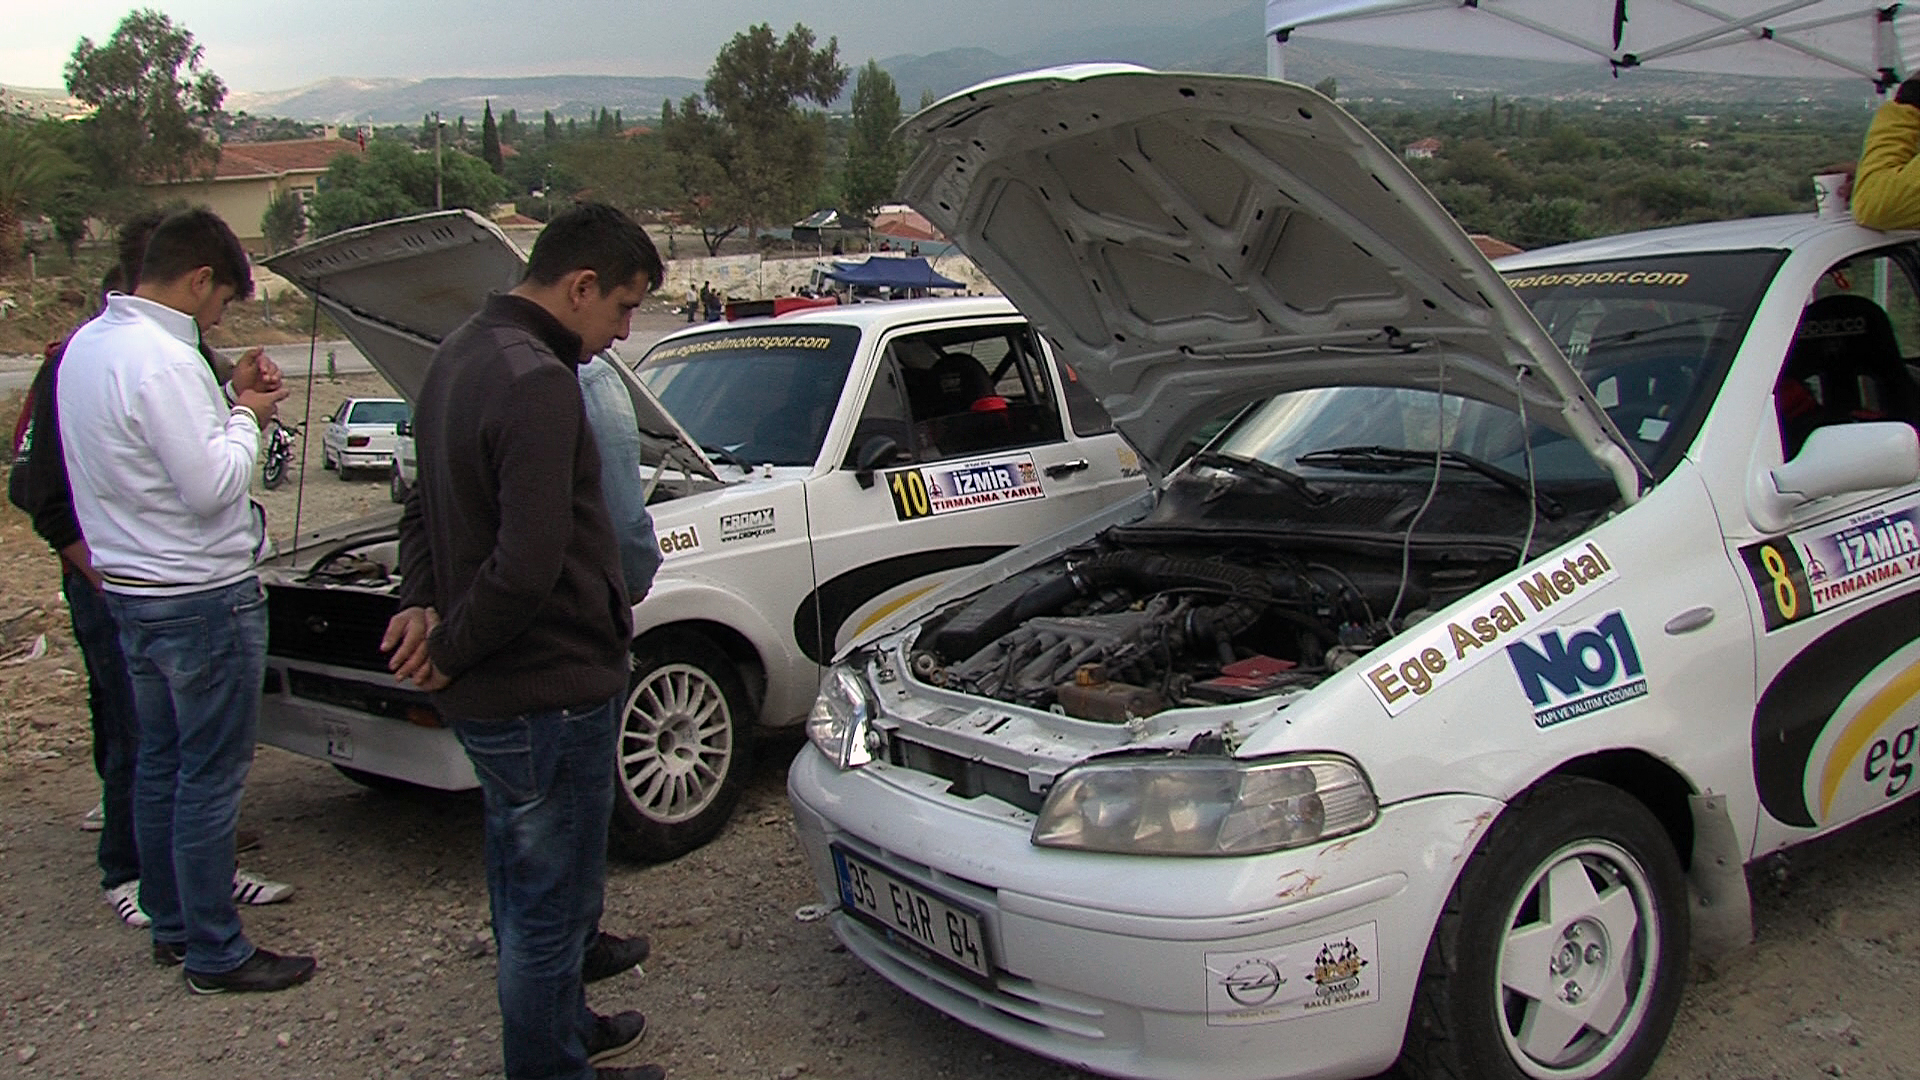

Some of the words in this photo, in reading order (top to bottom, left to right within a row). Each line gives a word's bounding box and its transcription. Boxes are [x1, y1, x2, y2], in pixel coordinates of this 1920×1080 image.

[1505, 271, 1690, 288] motorspor.com
[893, 471, 928, 517] 10
[933, 491, 999, 510] TIRMANMA
[952, 466, 1012, 495] İZMİR
[660, 526, 699, 553] etal
[1835, 518, 1920, 572] İZMİR
[1760, 545, 1796, 620] 8
[1813, 562, 1902, 604] TIRMANMA
[1367, 647, 1447, 705] Ege
[1447, 591, 1527, 661] Asal
[1517, 543, 1612, 612] Metal
[1864, 724, 1920, 797] eg
[849, 862, 877, 911] 35
[889, 882, 936, 945] EAR
[945, 911, 979, 967] 64
